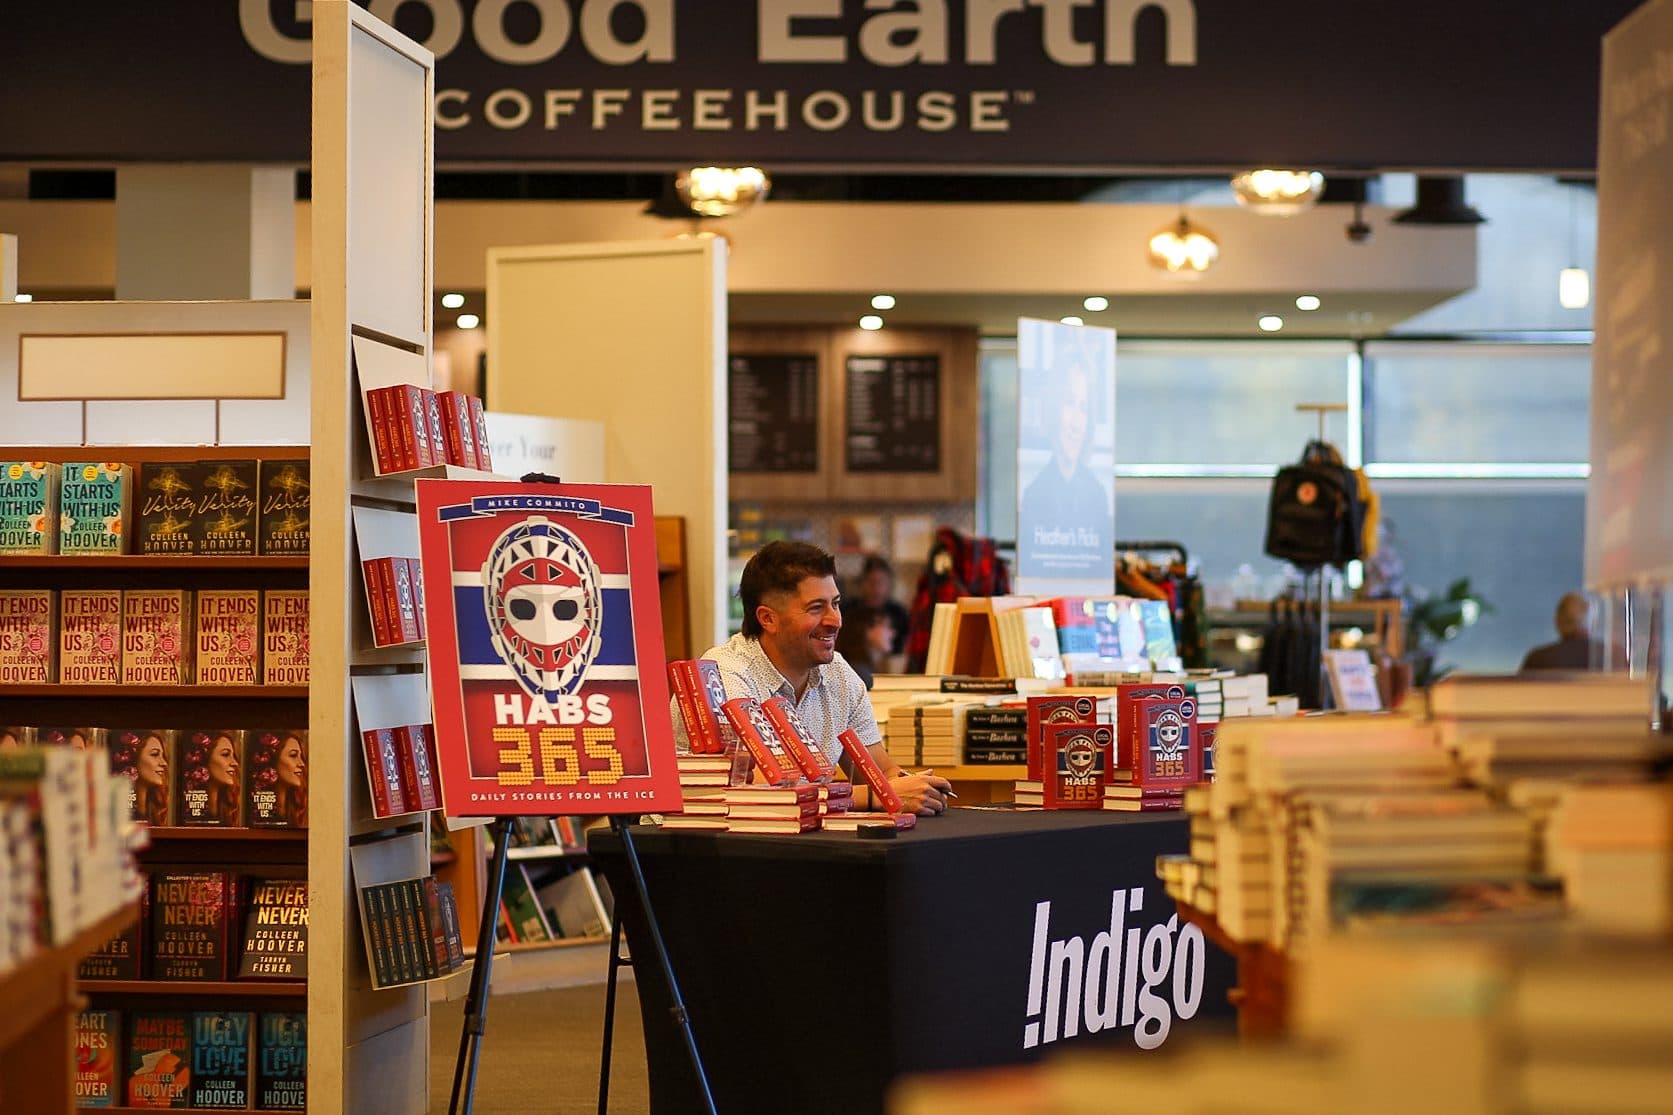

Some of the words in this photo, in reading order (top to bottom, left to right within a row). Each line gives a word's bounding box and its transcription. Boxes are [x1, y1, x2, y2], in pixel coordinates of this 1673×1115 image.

[66, 466, 78, 481] IT
[0, 482, 38, 498] TARTS
[64, 484, 114, 500] STARTS
[0, 500, 24, 516] ITH
[26, 500, 45, 516] US
[64, 502, 98, 518] WITH
[102, 502, 120, 518] US
[142, 494, 196, 518] Verity
[198, 493, 256, 516] Verity
[264, 493, 310, 514] Verit
[488, 499, 518, 508] MIKE
[526, 499, 586, 509] COMMITO
[0, 532, 41, 546] OOVER
[64, 534, 118, 548] HOOVER
[150, 532, 189, 541] COLLEEN
[206, 531, 246, 540] COLLEEN
[144, 541, 194, 551] HOOVER
[200, 540, 252, 550] HOOVER
[266, 540, 310, 550] HOOVE
[10, 598, 48, 614] ENDS
[65, 598, 80, 614] IT
[81, 598, 119, 614] ENDS
[126, 598, 140, 614] IT
[142, 598, 180, 614] ENDS
[201, 598, 214, 614] IT
[218, 598, 256, 614] ENDS
[268, 598, 281, 614] IT
[64, 616, 100, 632] WITH
[126, 616, 162, 633] WITH
[201, 616, 238, 633] WITH
[268, 616, 306, 633] WITH
[64, 635, 82, 651] US
[126, 635, 144, 652] US
[200, 636, 220, 652] US
[268, 636, 286, 652] US
[74, 656, 108, 664] COLLEEN
[136, 656, 169, 665] COLLEEN
[210, 656, 246, 666] COLLEEN
[2, 666, 46, 681] OOVER
[64, 666, 116, 682] HOOVER
[126, 667, 177, 682] HOOVER
[201, 667, 253, 682] HOOVER
[268, 668, 310, 682] HOOVE
[494, 693, 613, 726] HABS
[492, 727, 624, 786] 365
[1156, 752, 1183, 762] HABS
[1155, 761, 1184, 777] 365
[1064, 778, 1096, 786] HABS
[471, 793, 506, 802] DAILY
[512, 792, 562, 801] STORIES
[569, 792, 602, 800] FROM
[608, 792, 630, 800] THE
[635, 791, 656, 799] ICE
[1064, 786, 1098, 800] 365
[157, 884, 208, 903] NEVER
[253, 886, 306, 905] NEVER
[164, 905, 216, 925] NEVER
[257, 906, 310, 926] NEVER
[256, 930, 300, 940] COLLEEN
[158, 942, 214, 954] HOOVER
[247, 940, 305, 953] HOOVER
[252, 963, 292, 973] FISHER
[1024, 887, 1205, 1050] Indigo
[74, 1013, 107, 1030] ART
[137, 1020, 184, 1036] MAYBE
[195, 1014, 248, 1046] UGLY
[264, 1015, 306, 1046] UGL
[133, 1038, 187, 1050] SOMEDAY
[194, 1046, 247, 1076] LOVE
[74, 1072, 100, 1081] LLEEN
[205, 1080, 236, 1089] COLLEEN
[75, 1082, 108, 1096] OVER
[134, 1083, 184, 1098] HOOVER
[196, 1090, 245, 1104] HOOVER
[264, 1090, 304, 1105] HOOVE
